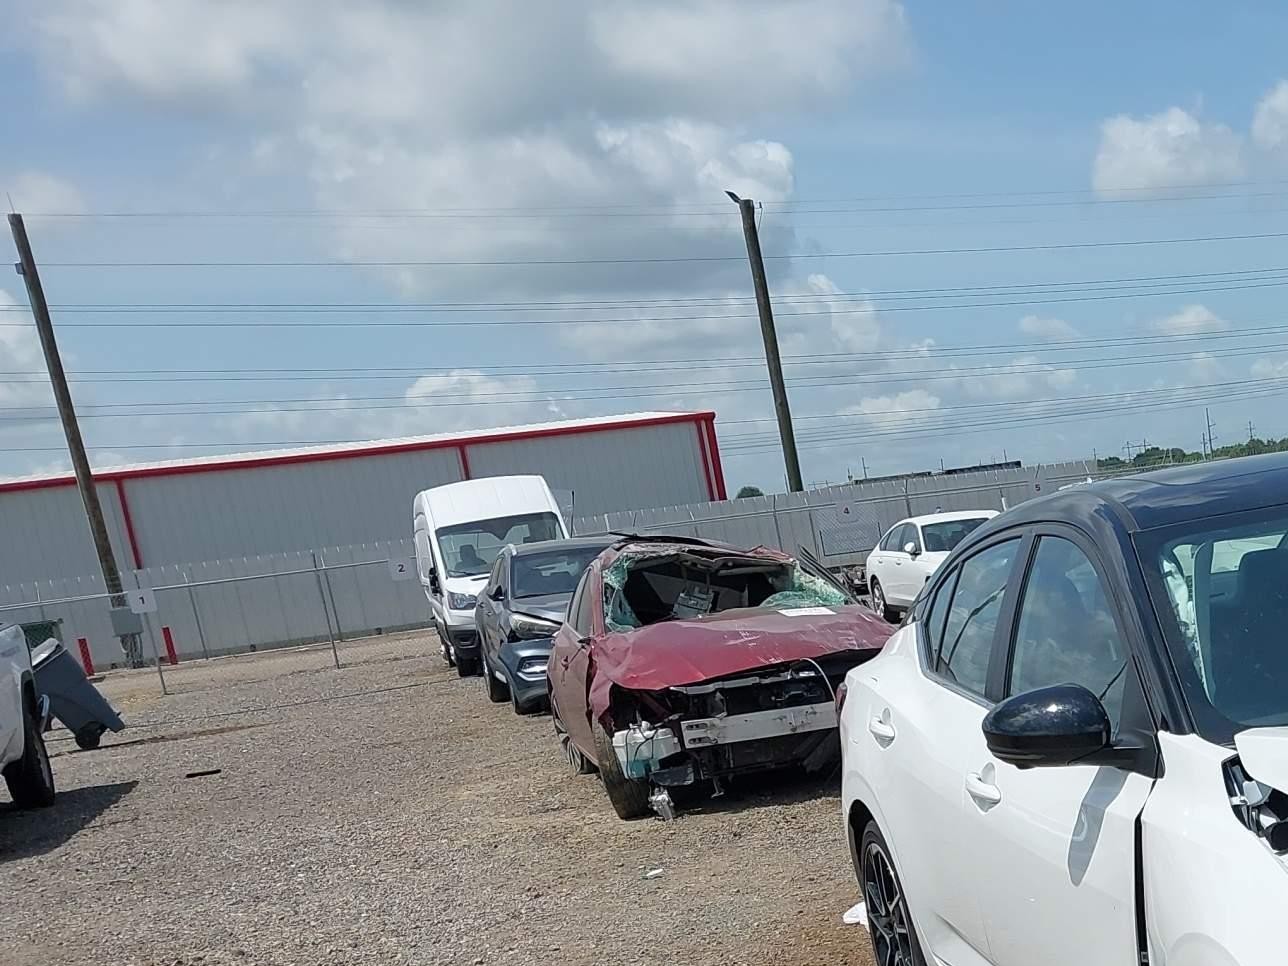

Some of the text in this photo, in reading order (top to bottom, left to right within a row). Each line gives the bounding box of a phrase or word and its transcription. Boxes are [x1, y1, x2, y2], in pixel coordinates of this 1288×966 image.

[1034, 483, 1041, 491] 5
[398, 564, 405, 572] 2
[138, 596, 145, 605] 1
